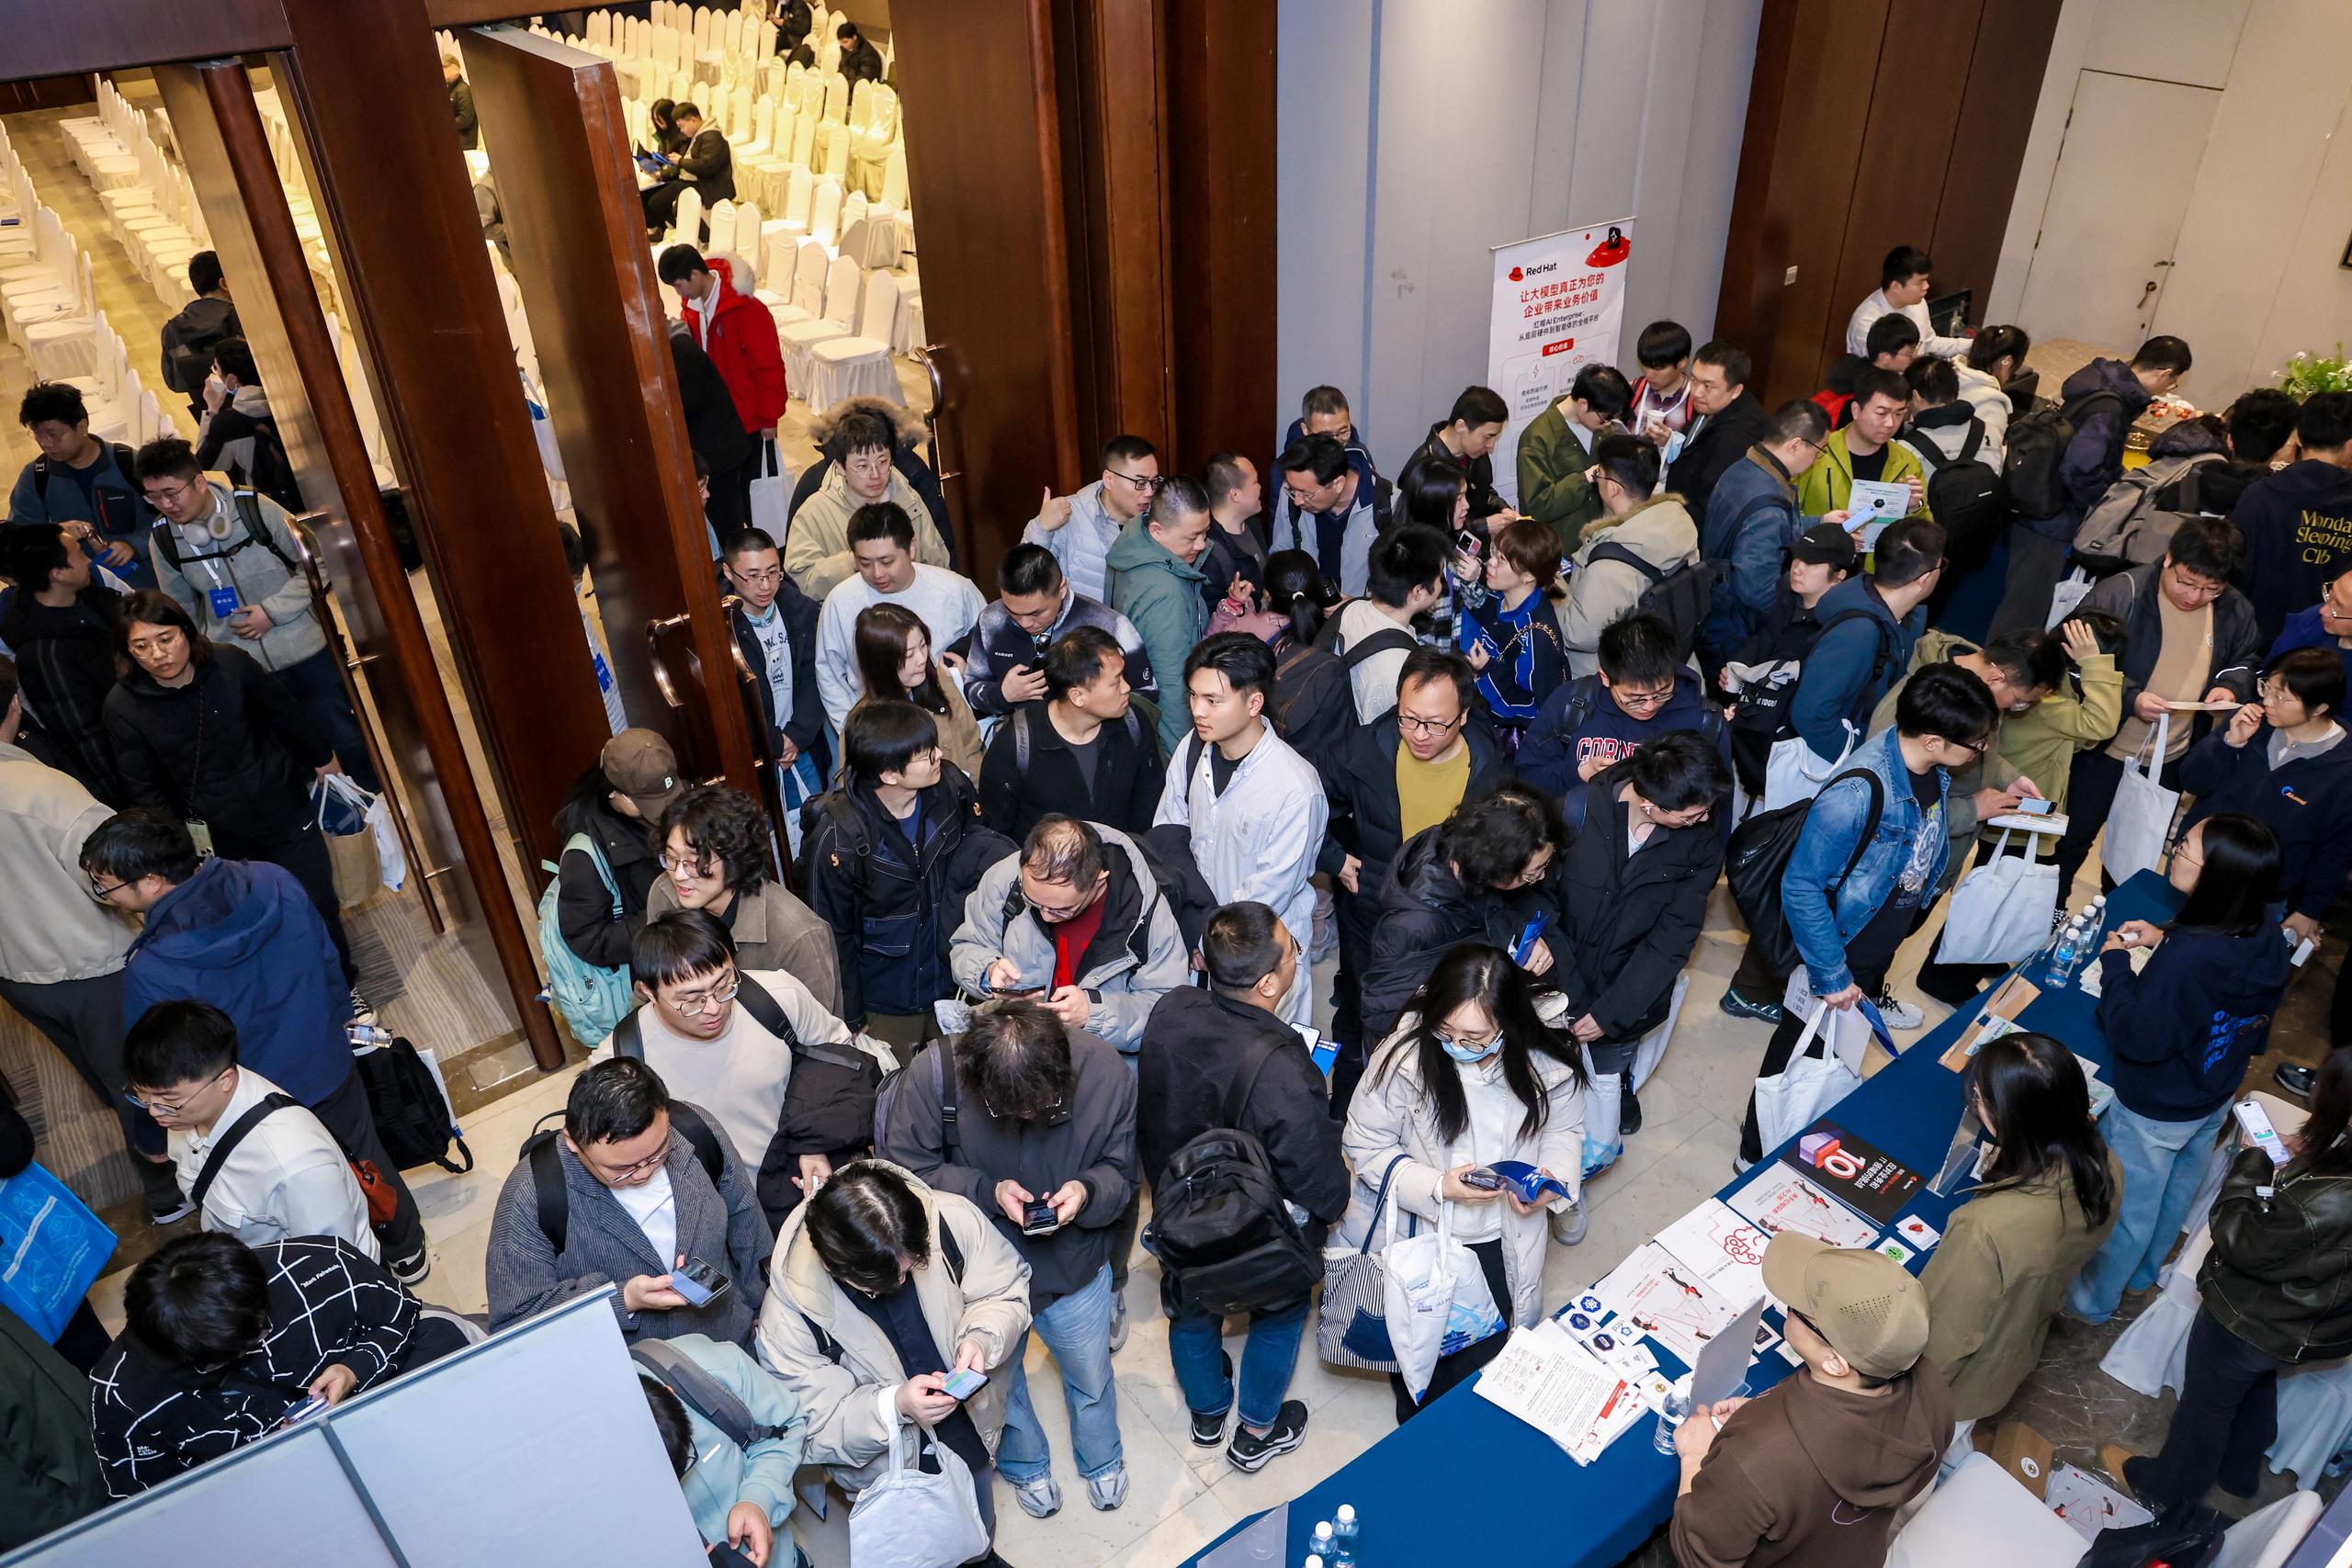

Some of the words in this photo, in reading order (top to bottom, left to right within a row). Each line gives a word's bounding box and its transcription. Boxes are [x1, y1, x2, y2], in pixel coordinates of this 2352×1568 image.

[1526, 265, 1542, 277] Red
[1543, 262, 1557, 274] Hat
[1520, 273, 1604, 303] 让大模型真正为您的
[1523, 289, 1599, 318] 企业带来业务价值
[1577, 738, 1644, 763] CORN
[664, 776, 673, 789] B
[1824, 1148, 1866, 1178] 10
